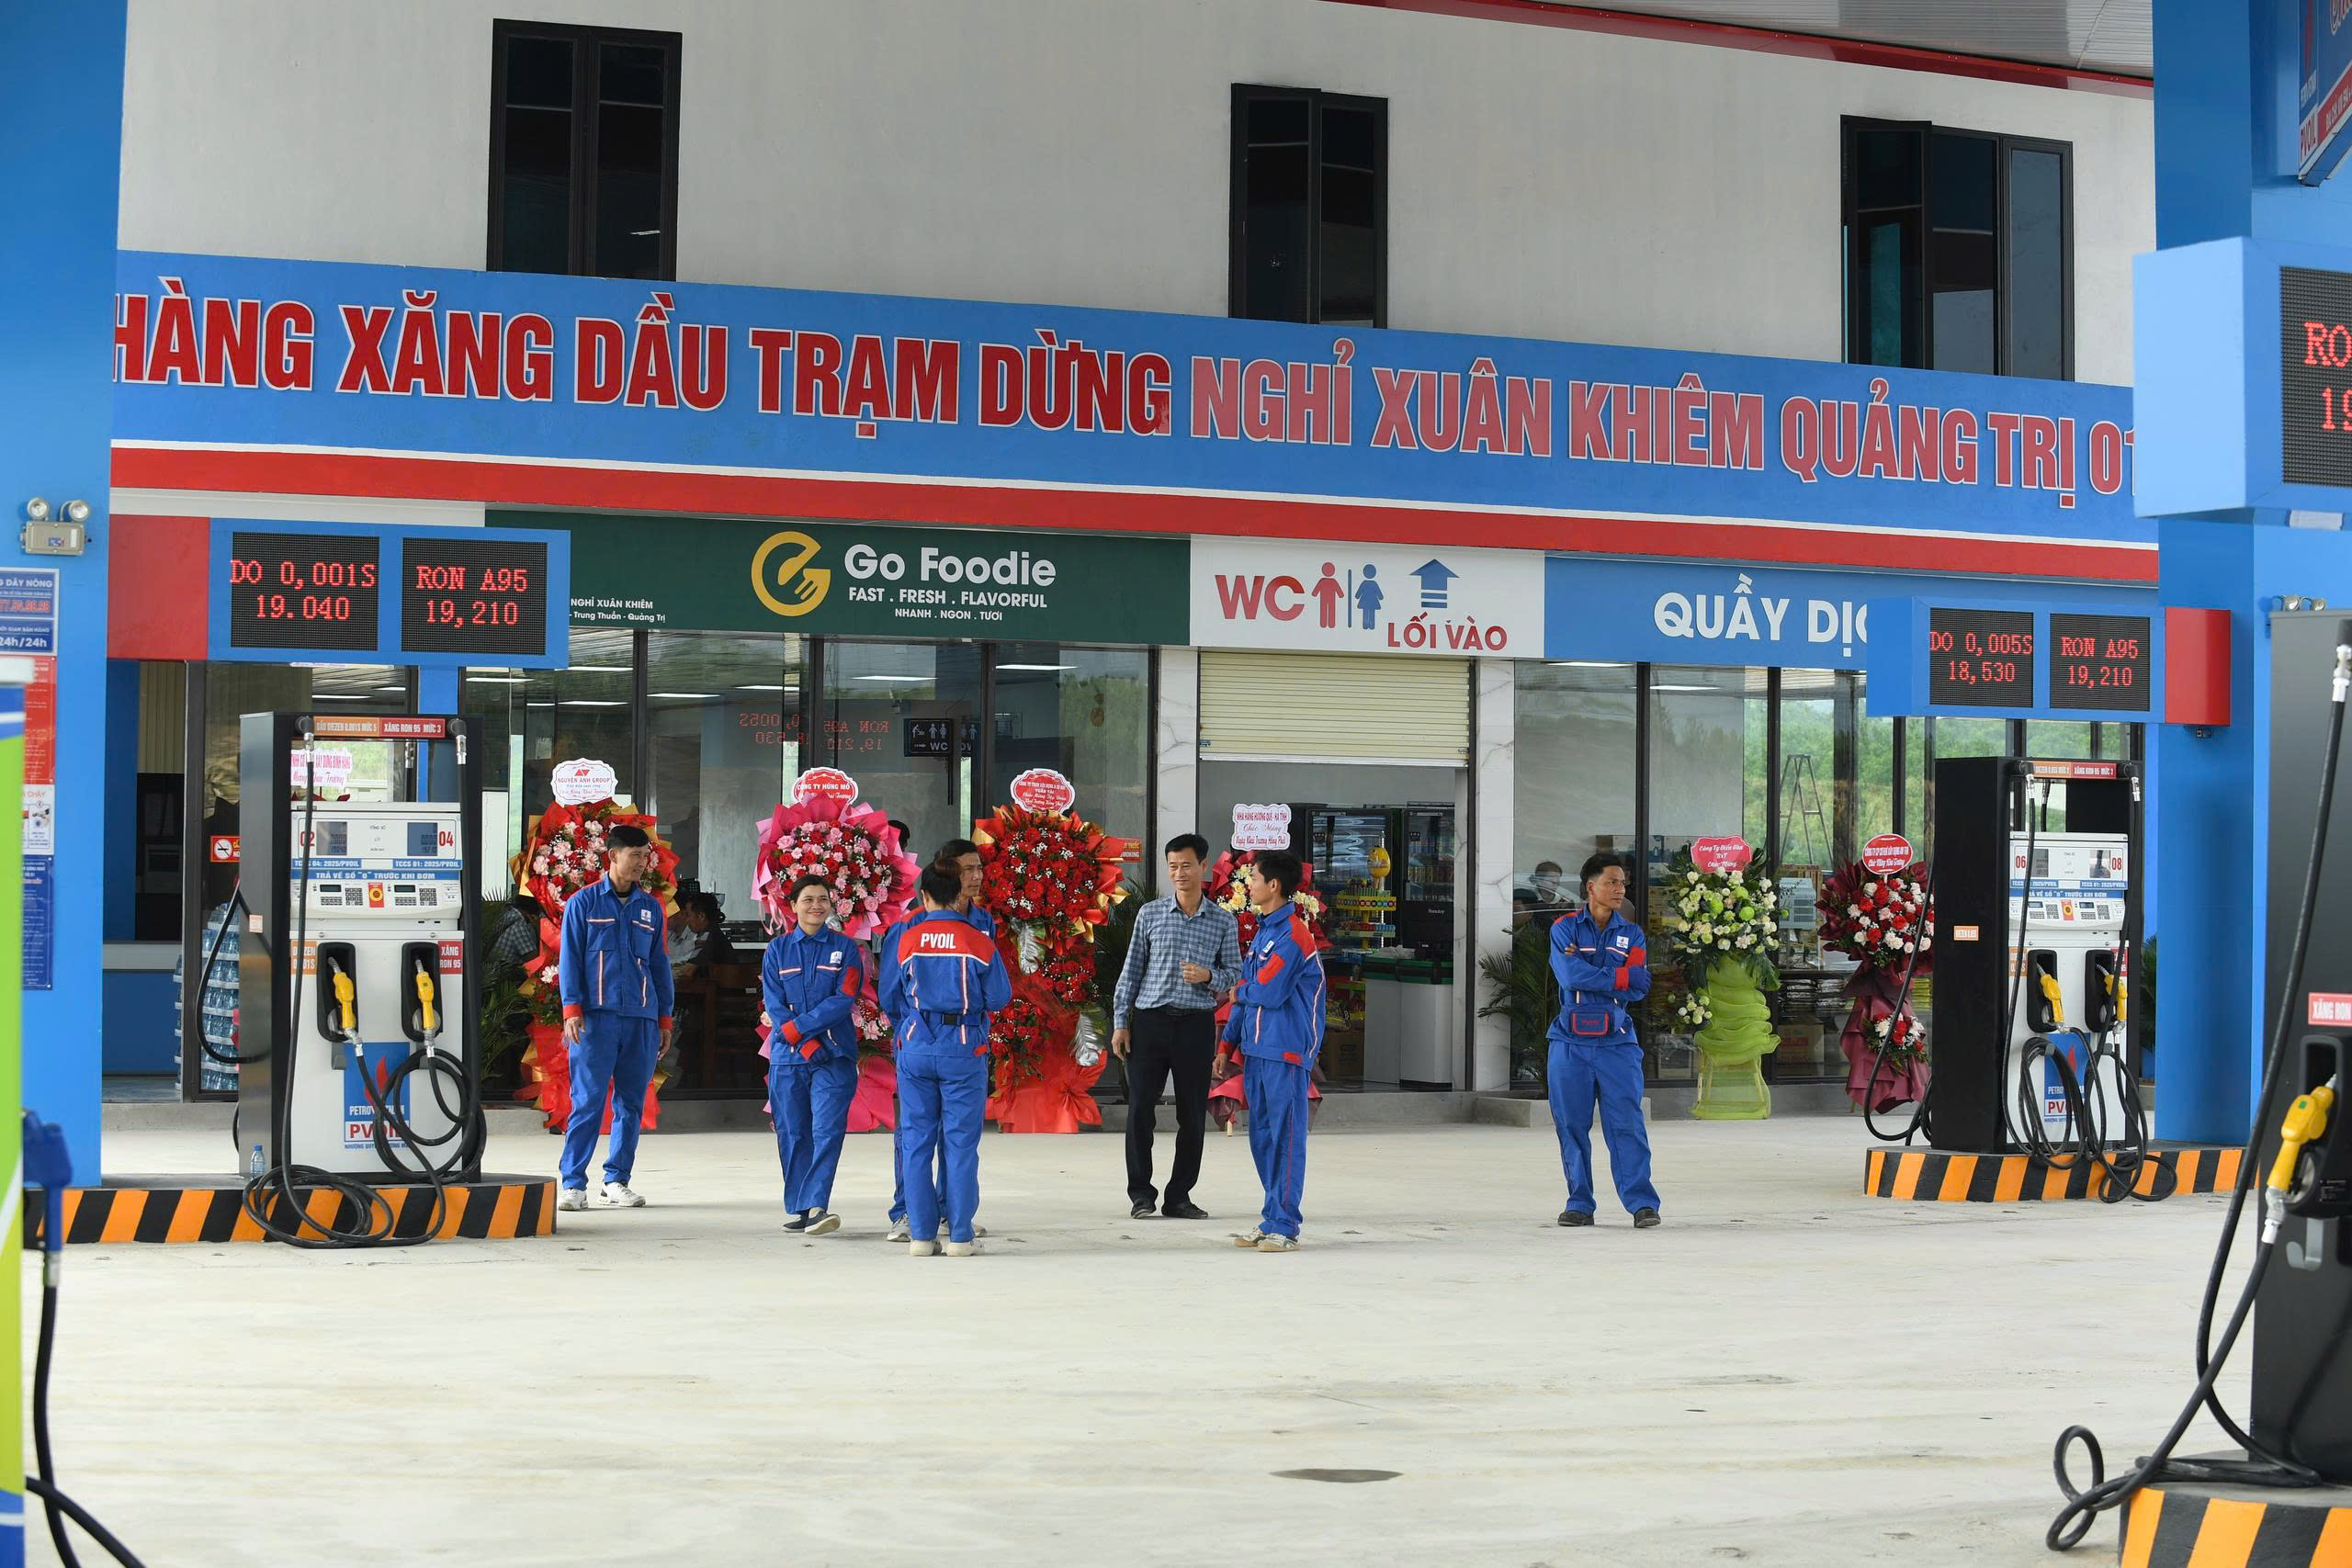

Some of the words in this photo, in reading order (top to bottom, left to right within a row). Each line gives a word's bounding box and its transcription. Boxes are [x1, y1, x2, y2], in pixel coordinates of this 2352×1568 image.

[113, 276, 315, 391] HÀNG
[336, 289, 553, 402] XĂNG
[574, 291, 729, 412] DẦU
[749, 327, 960, 439] TRẠM
[978, 328, 1171, 436] DỪNG
[1192, 337, 1356, 446] NGHỈ
[1372, 356, 1552, 457] XUÂN
[1568, 372, 1765, 471] KHIÊM
[1781, 377, 1978, 485] QUẢNG
[1987, 412, 2075, 510] TRỊ
[231, 559, 263, 584] DO
[280, 561, 377, 590] 0,001S
[844, 544, 905, 581] Go
[921, 547, 1056, 587] Foodie
[416, 566, 466, 590] RON
[480, 568, 528, 592] A95
[257, 594, 350, 619] 19.040
[571, 596, 594, 607] NGHỈ
[597, 597, 622, 608] XUÂN
[626, 599, 653, 609] KHIÊM
[849, 587, 885, 602] FAST
[899, 589, 945, 604] FRESH
[961, 591, 1047, 607] FLAVORFUL
[1215, 575, 1306, 621] WC
[426, 600, 519, 627] 19,210
[574, 611, 595, 620] Trung
[628, 613, 654, 623] Quảng
[895, 608, 932, 618] NHANH
[940, 610, 971, 619] NGON
[979, 610, 1002, 621] TƯƠI
[1654, 573, 1790, 641] QUẦY
[1807, 599, 1867, 658] DỊ
[1387, 611, 1436, 649] LỐI
[1445, 615, 1508, 650] VÀO
[1929, 631, 1953, 652] DO
[1965, 632, 2033, 657] 0,005S
[2061, 636, 2095, 657] RON
[2105, 638, 2139, 659] A95
[1950, 660, 2024, 684] 18,530
[2068, 665, 2132, 689] 19,210
[930, 742, 948, 750] WC
[438, 831, 454, 846] 04
[2016, 856, 2026, 869] 06
[2112, 857, 2122, 870] 08
[441, 944, 458, 955] XĂNG
[921, 933, 956, 949] PVOIL
[453, 959, 461, 968] 95
